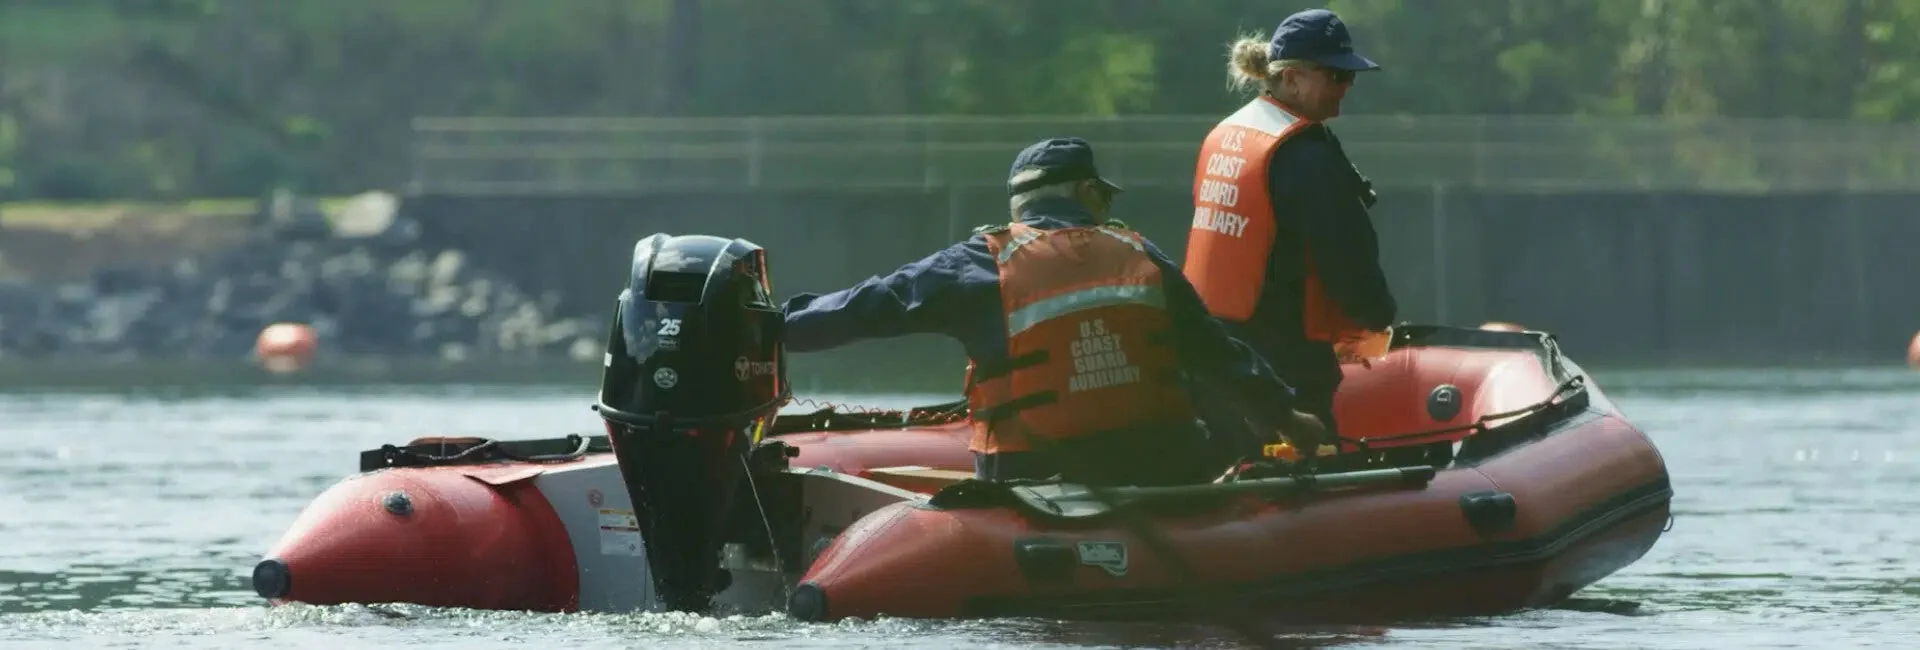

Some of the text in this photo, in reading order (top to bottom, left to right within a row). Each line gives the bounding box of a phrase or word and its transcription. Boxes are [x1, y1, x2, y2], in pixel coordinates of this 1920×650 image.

[1206, 153, 1247, 179] COAST
[1199, 179, 1239, 207] GUARD
[657, 318, 682, 335] 25
[1080, 318, 1110, 337] U.S.
[1070, 333, 1122, 357] COAST
[1074, 351, 1127, 373] GUARD
[1069, 366, 1140, 392] AUXILIARY
